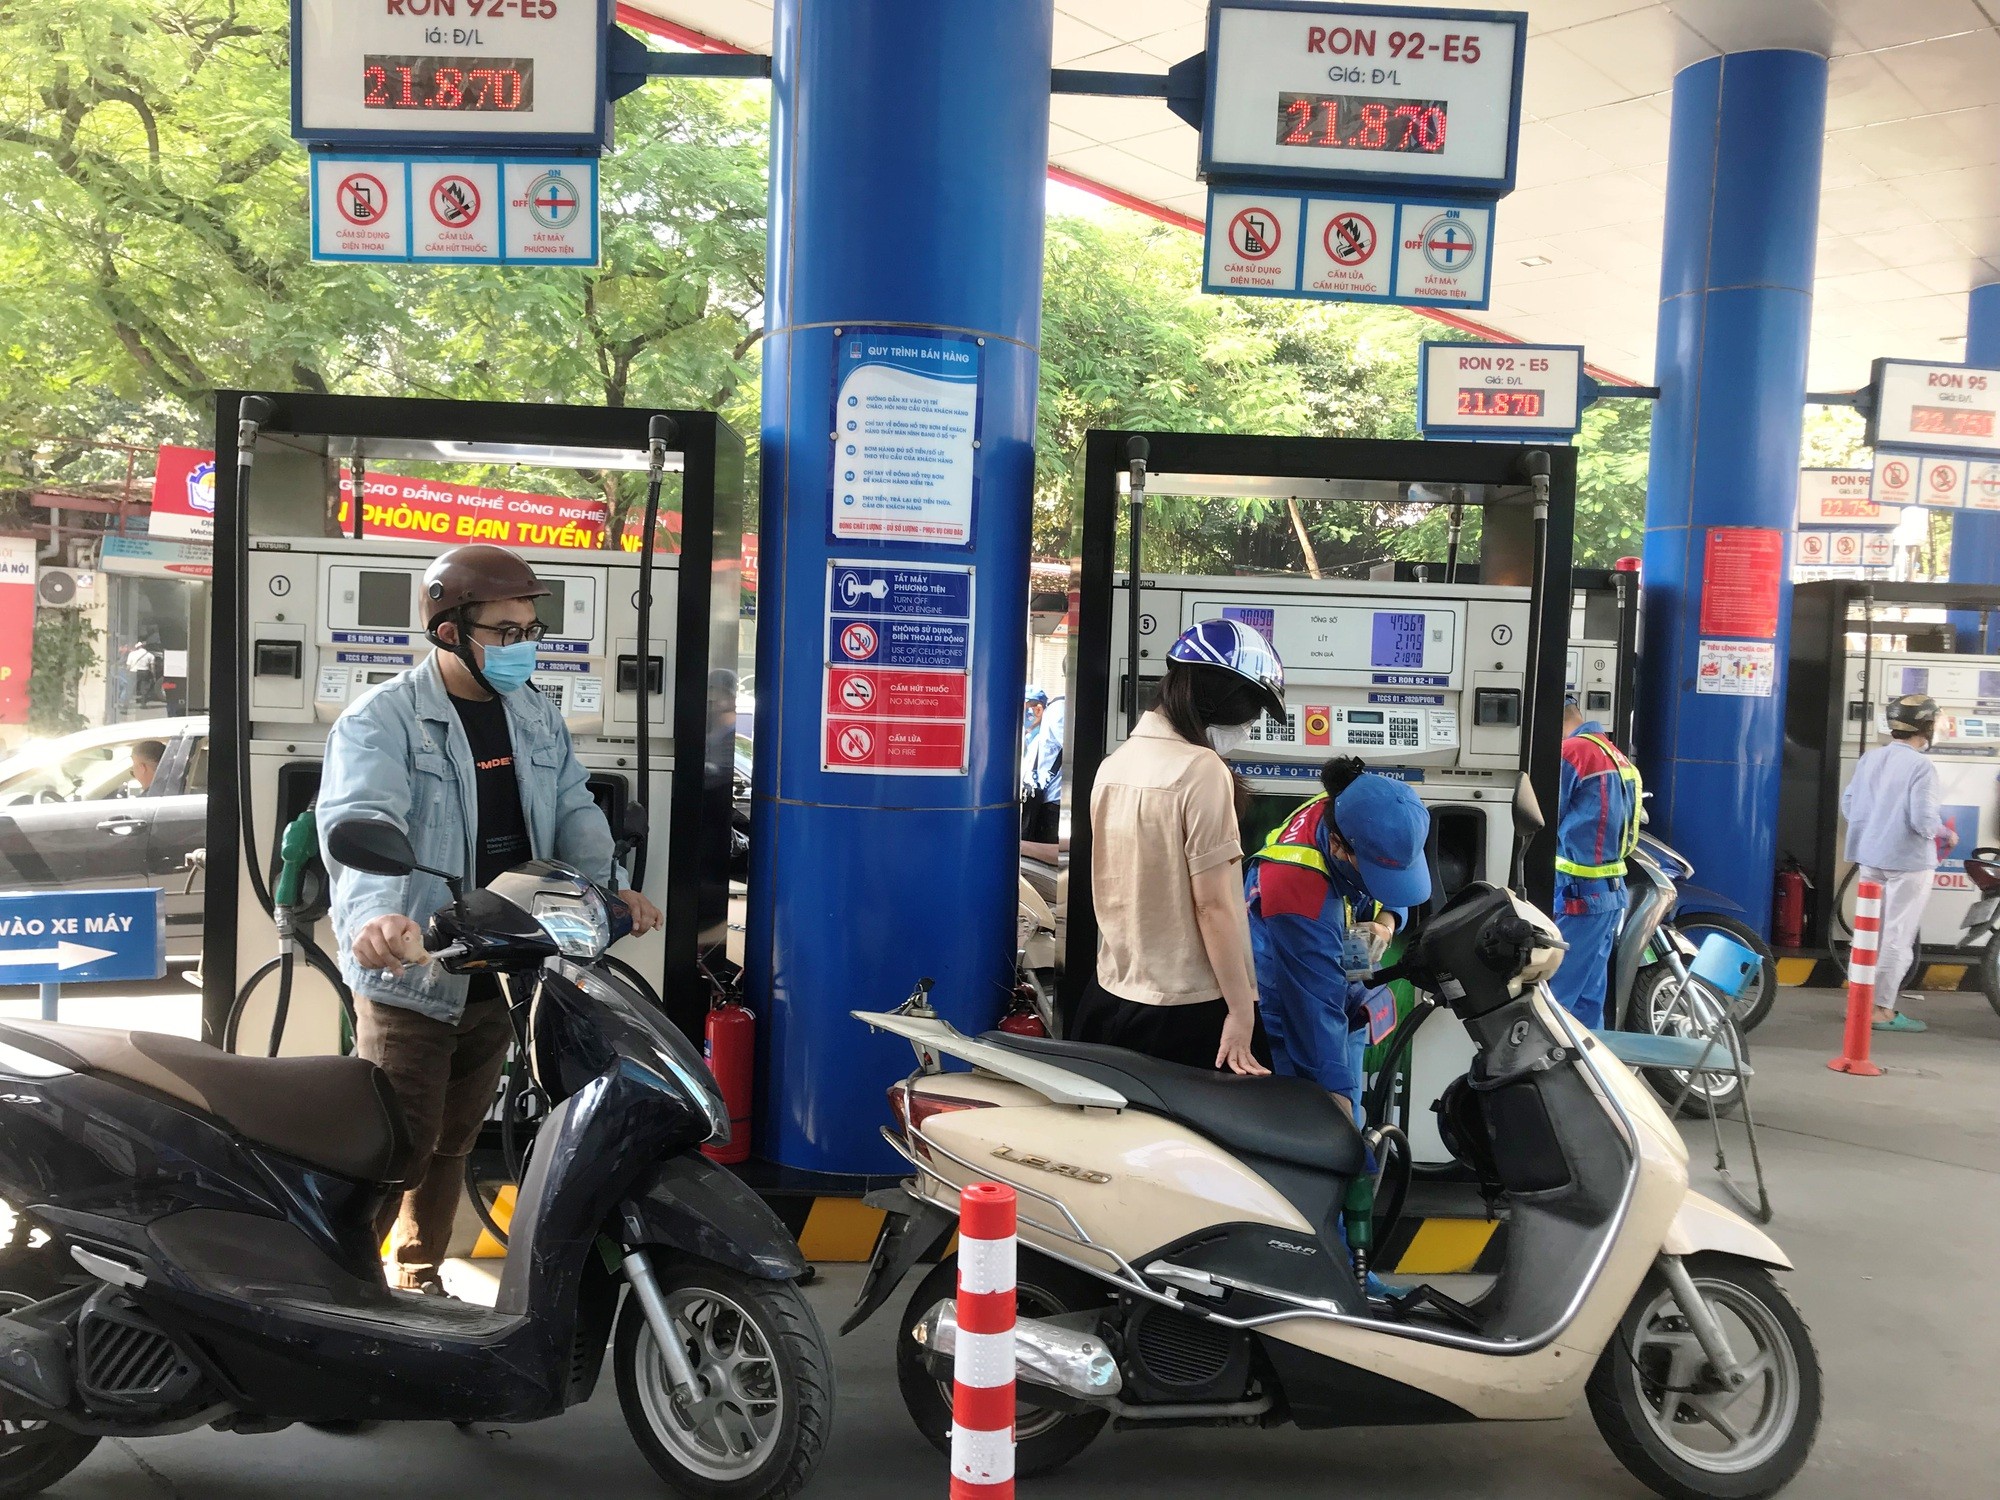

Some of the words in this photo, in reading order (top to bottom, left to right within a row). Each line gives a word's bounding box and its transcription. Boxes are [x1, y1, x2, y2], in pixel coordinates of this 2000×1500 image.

[453, 28, 483, 46] Đ/L
[1307, 26, 1377, 57] RON
[1389, 31, 1482, 64] 92-E5
[1328, 65, 1365, 83] Giá:
[1372, 70, 1402, 86] Đ/L
[363, 66, 521, 108] 21.870
[1287, 99, 1448, 151] 21.870
[1446, 210, 1460, 219] ON
[1405, 241, 1423, 249] OFF
[1224, 264, 1244, 273] CẤM
[1257, 267, 1281, 276] DỤNG
[1327, 269, 1347, 279] CẤM
[1348, 271, 1364, 280] LỬA
[1231, 276, 1250, 285] ĐIỆN
[1251, 278, 1274, 286] THOẠI
[1313, 281, 1332, 290] CẤM
[1334, 282, 1349, 291] HÚT
[1351, 282, 1377, 292] THUỐC
[1415, 287, 1447, 297] PHƯƠNG
[1449, 289, 1467, 298] TIỆN
[868, 346, 889, 356] QUY
[890, 346, 918, 358] TRÌNH
[921, 347, 940, 359] BÁN
[943, 349, 969, 362] HÀNG
[1459, 357, 1491, 370] RON
[1496, 358, 1514, 371] 92
[1530, 358, 1549, 371] E5
[1485, 375, 1503, 385] Giá:
[1507, 377, 1523, 386] Đ/L
[1928, 372, 1963, 389] RON
[1968, 375, 1988, 391] 95
[1457, 392, 1540, 416] 21.870
[1831, 476, 1857, 485] RON
[402, 484, 453, 503] ĐẲNG
[457, 493, 505, 510] NGHỀ
[508, 498, 554, 516] CÔNG
[559, 504, 607, 523] NGHIỆ
[457, 520, 509, 540] BAN
[517, 520, 592, 548] TUYỂN
[11, 562, 29, 576] NỘI
[910, 574, 928, 583] MÁY
[894, 583, 928, 593] PHƯƠNG
[930, 584, 946, 594] TIỆN
[894, 596, 912, 604] TURN
[914, 596, 928, 605] OFF
[893, 604, 914, 613] YOUR
[916, 606, 943, 614] ENGINE
[1143, 619, 1149, 629] 5
[1310, 615, 1327, 623] TỔNG
[1328, 616, 1338, 624] SỐ
[892, 624, 920, 633] KHÔNG
[922, 624, 931, 633] SỬ
[932, 627, 952, 635] DỤNG
[1499, 629, 1505, 639] 7
[358, 635, 373, 643] RON
[892, 633, 909, 641] ĐIỆN
[910, 634, 933, 642] THOẠI
[943, 634, 964, 643] ĐỘNG
[1318, 633, 1328, 642] LÍT
[891, 647, 904, 655] USE
[906, 647, 916, 655] OF
[918, 648, 963, 657] CELLPHONES
[899, 655, 914, 663] NOT
[916, 656, 950, 665] ALLOWED
[890, 682, 909, 692] CẤM
[911, 683, 924, 692] HÚT
[925, 684, 950, 693] THUỐC
[890, 697, 902, 705] NO
[904, 698, 939, 706] SMOKING
[888, 733, 906, 742] CẤM
[908, 734, 922, 743] LỬA
[888, 748, 900, 756] NO
[1246, 764, 1262, 775] SỐ
[1266, 765, 1281, 776] VỀ
[0, 915, 45, 937] VÀO
[51, 918, 78, 934] XE
[85, 913, 133, 933] MÁY
[989, 1145, 1113, 1185] LEAD
